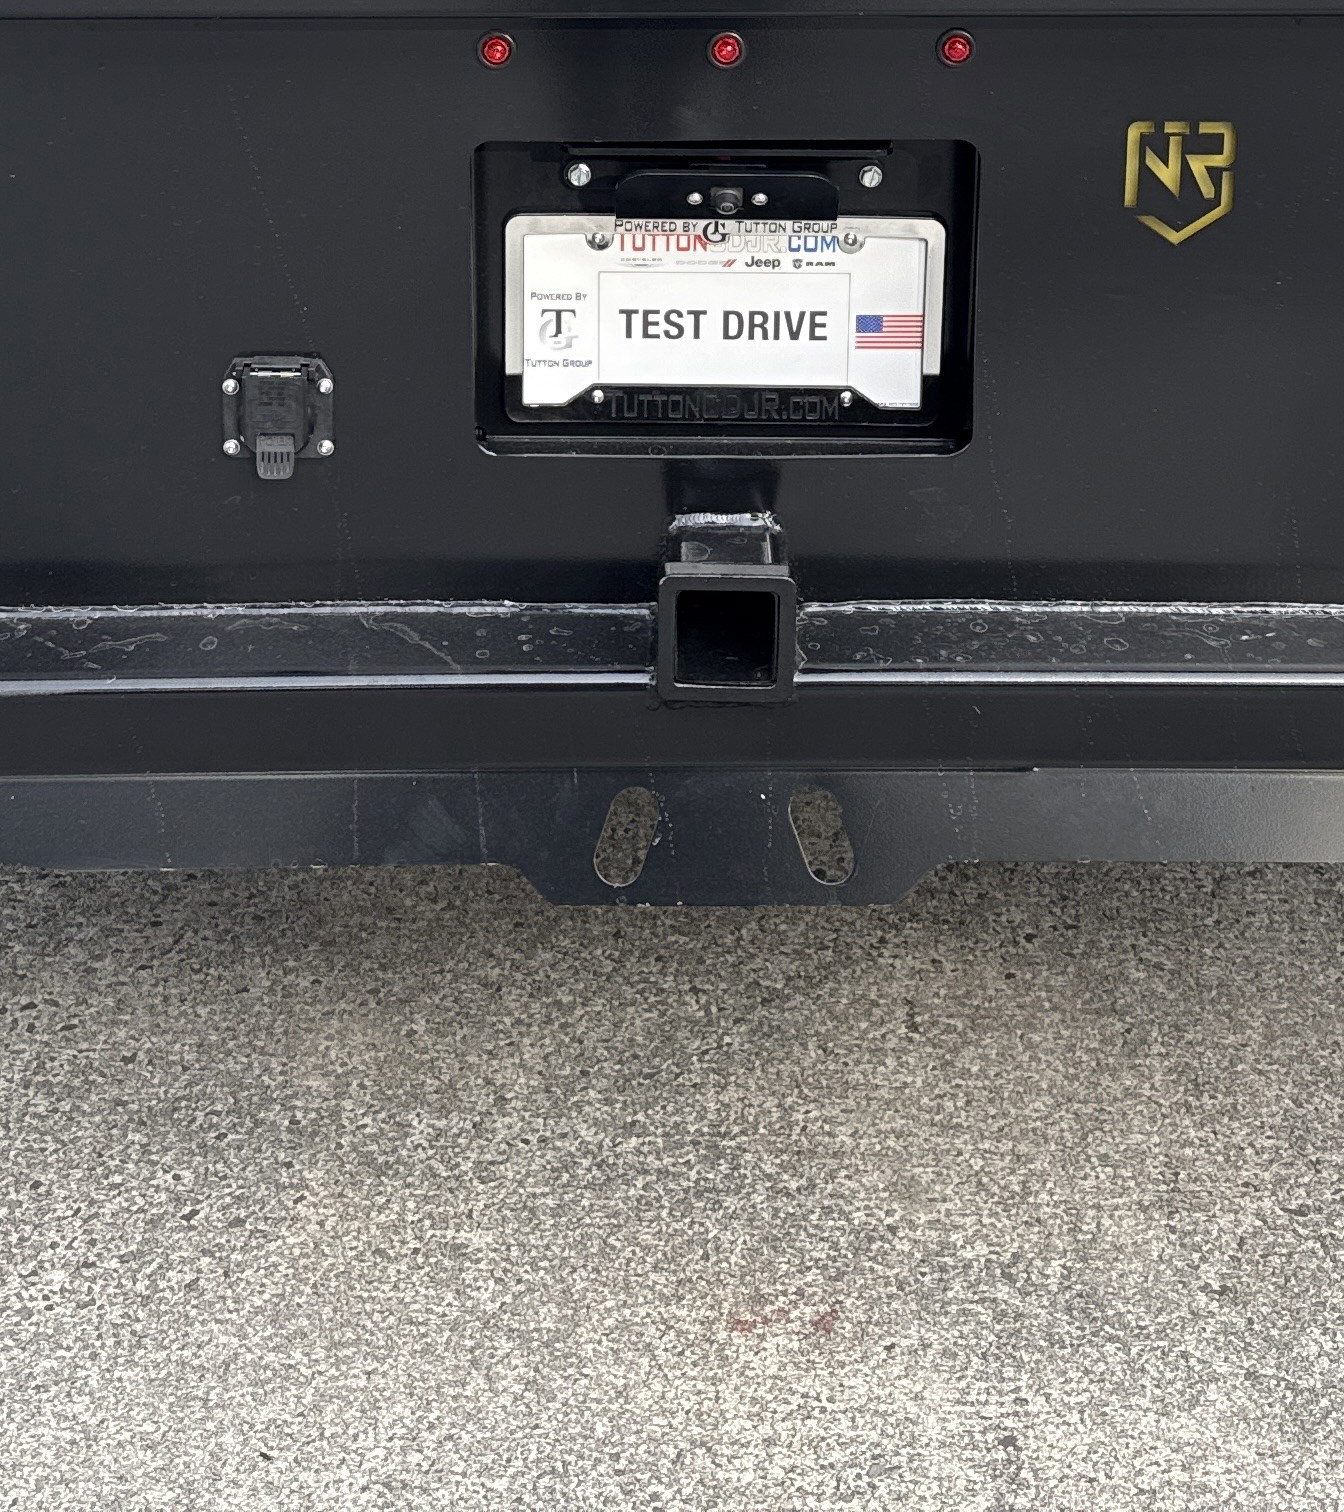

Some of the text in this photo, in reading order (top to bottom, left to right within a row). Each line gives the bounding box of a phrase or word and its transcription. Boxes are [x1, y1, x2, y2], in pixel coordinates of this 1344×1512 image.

[736, 220, 787, 233] TUTTON
[792, 221, 838, 234] GROUP
[744, 255, 782, 271] Jeep
[805, 260, 836, 268] RAM
[618, 308, 829, 342] TEST DRIVE
